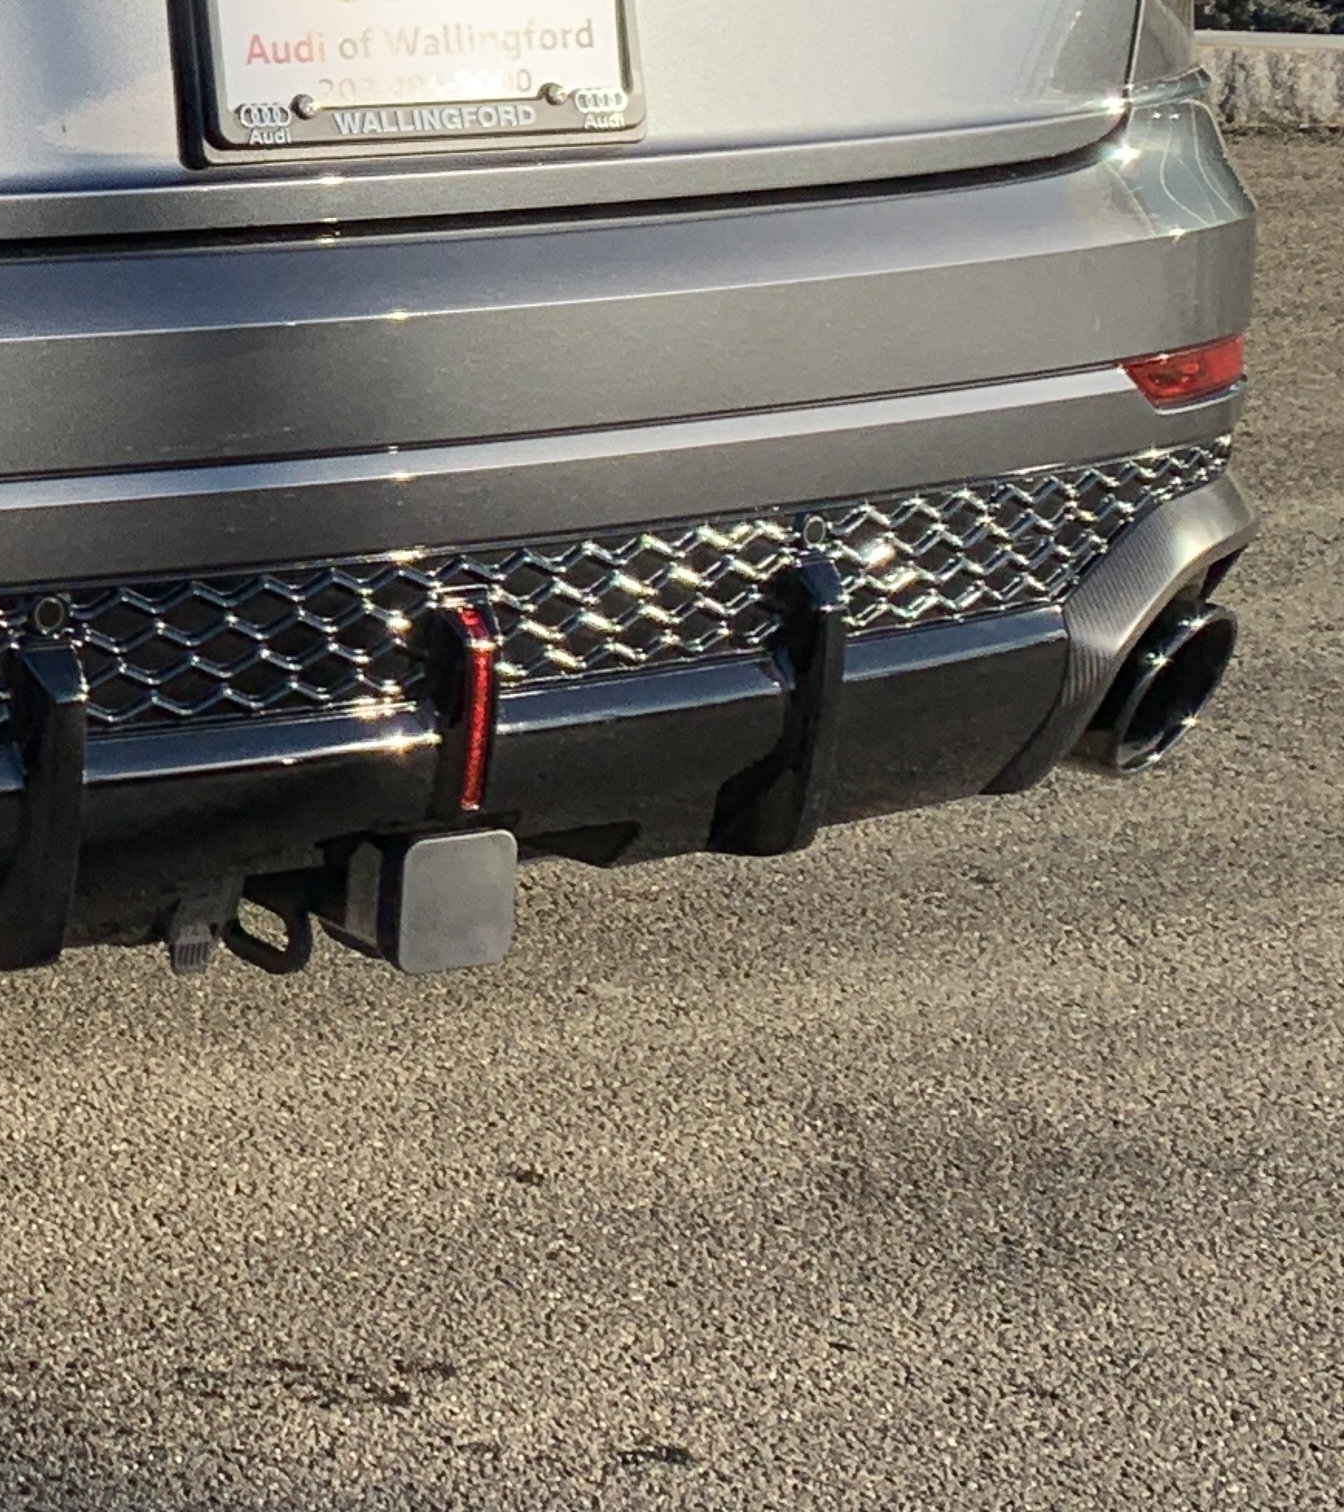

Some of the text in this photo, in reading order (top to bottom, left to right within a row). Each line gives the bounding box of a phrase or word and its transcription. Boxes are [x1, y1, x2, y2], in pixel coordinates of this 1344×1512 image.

[245, 17, 594, 65] Audi of Wallingford
[332, 104, 537, 136] WALLINGFORD
[584, 113, 626, 130] Audi
[248, 128, 292, 145] Audi
